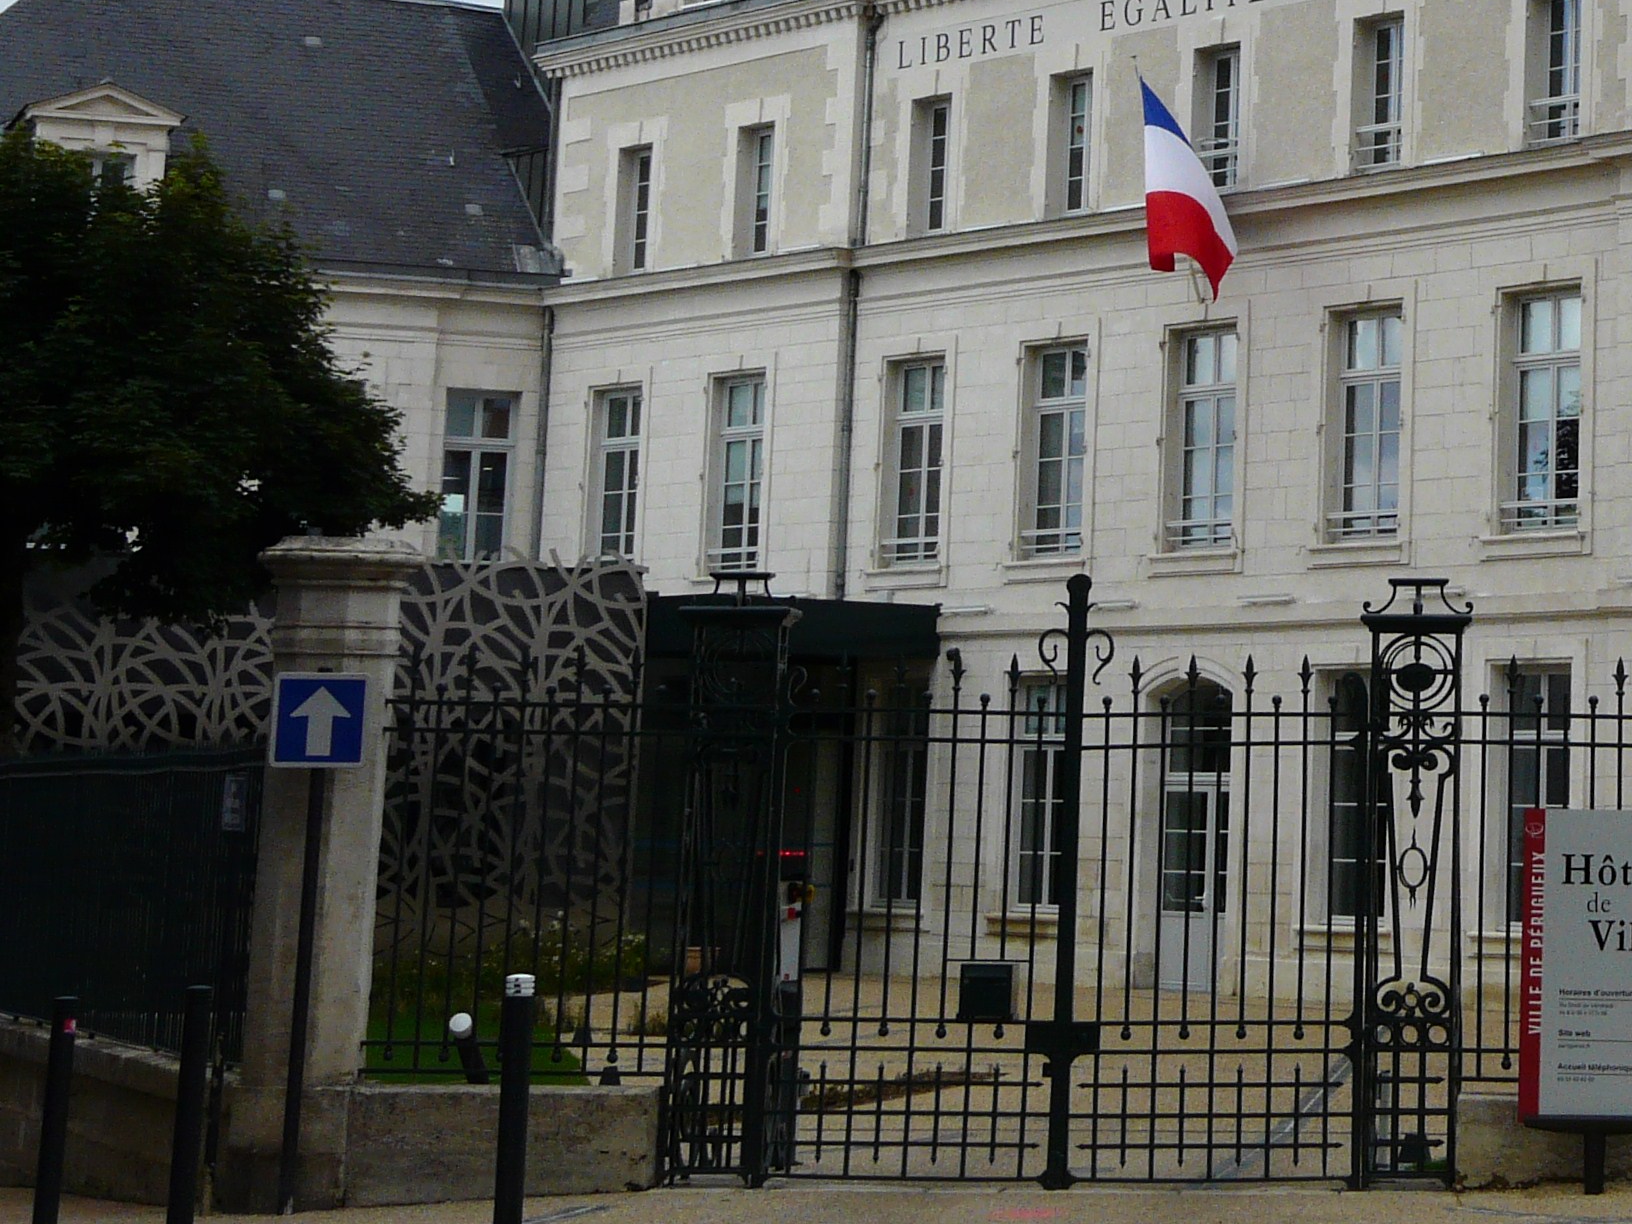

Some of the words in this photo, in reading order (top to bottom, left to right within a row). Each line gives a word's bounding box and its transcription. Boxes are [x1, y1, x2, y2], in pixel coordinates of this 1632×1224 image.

[897, 14, 1045, 70] LIBERTE
[1529, 851, 1545, 949] PÉRIGUEUX
[1586, 891, 1611, 913] de
[1529, 956, 1544, 977] DE
[1528, 986, 1543, 1035] VILLE
